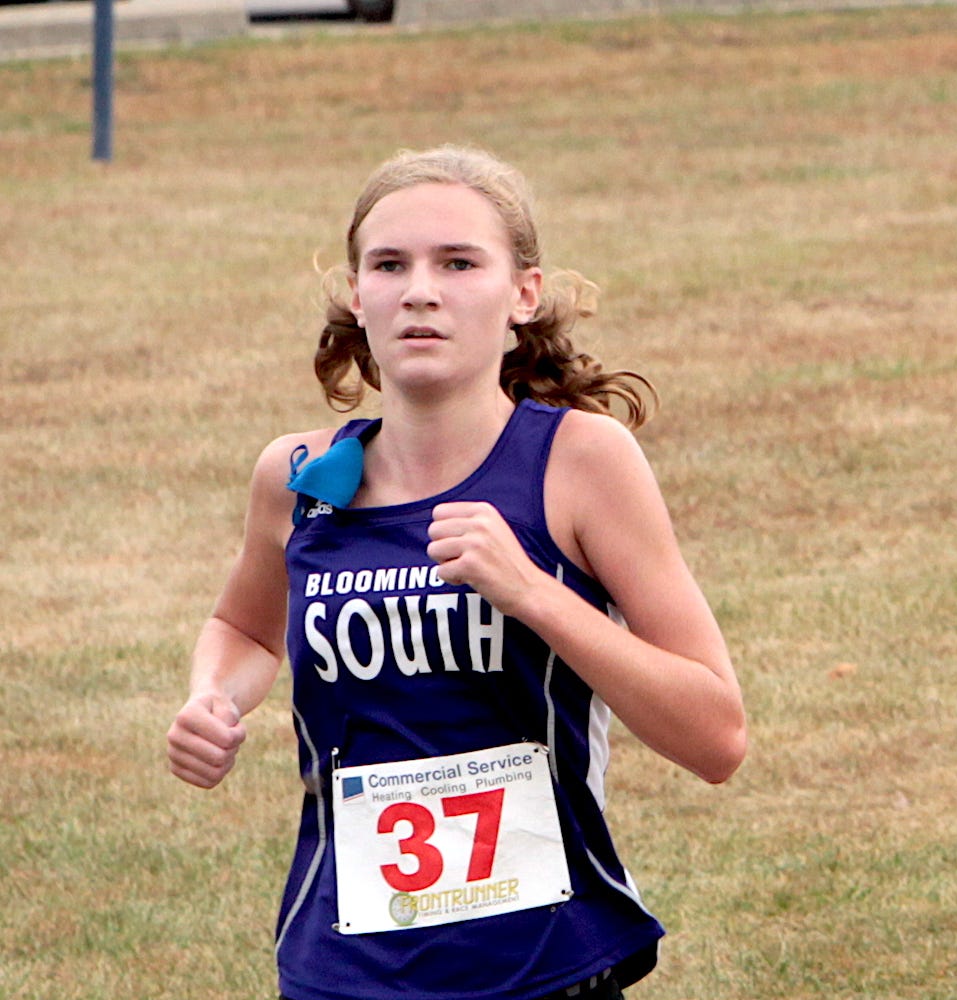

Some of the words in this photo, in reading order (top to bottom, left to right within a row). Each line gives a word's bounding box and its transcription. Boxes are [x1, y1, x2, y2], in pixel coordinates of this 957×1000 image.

[305, 565, 445, 597] BLOOMING
[304, 592, 504, 683] SOUTH
[368, 764, 462, 789] Commercial
[467, 753, 533, 776] Service
[372, 789, 412, 803] Heating
[420, 782, 467, 798] Cooling
[475, 770, 533, 789] Plumbing
[376, 787, 505, 893] 37
[401, 878, 520, 913] FRONTRUNNER
